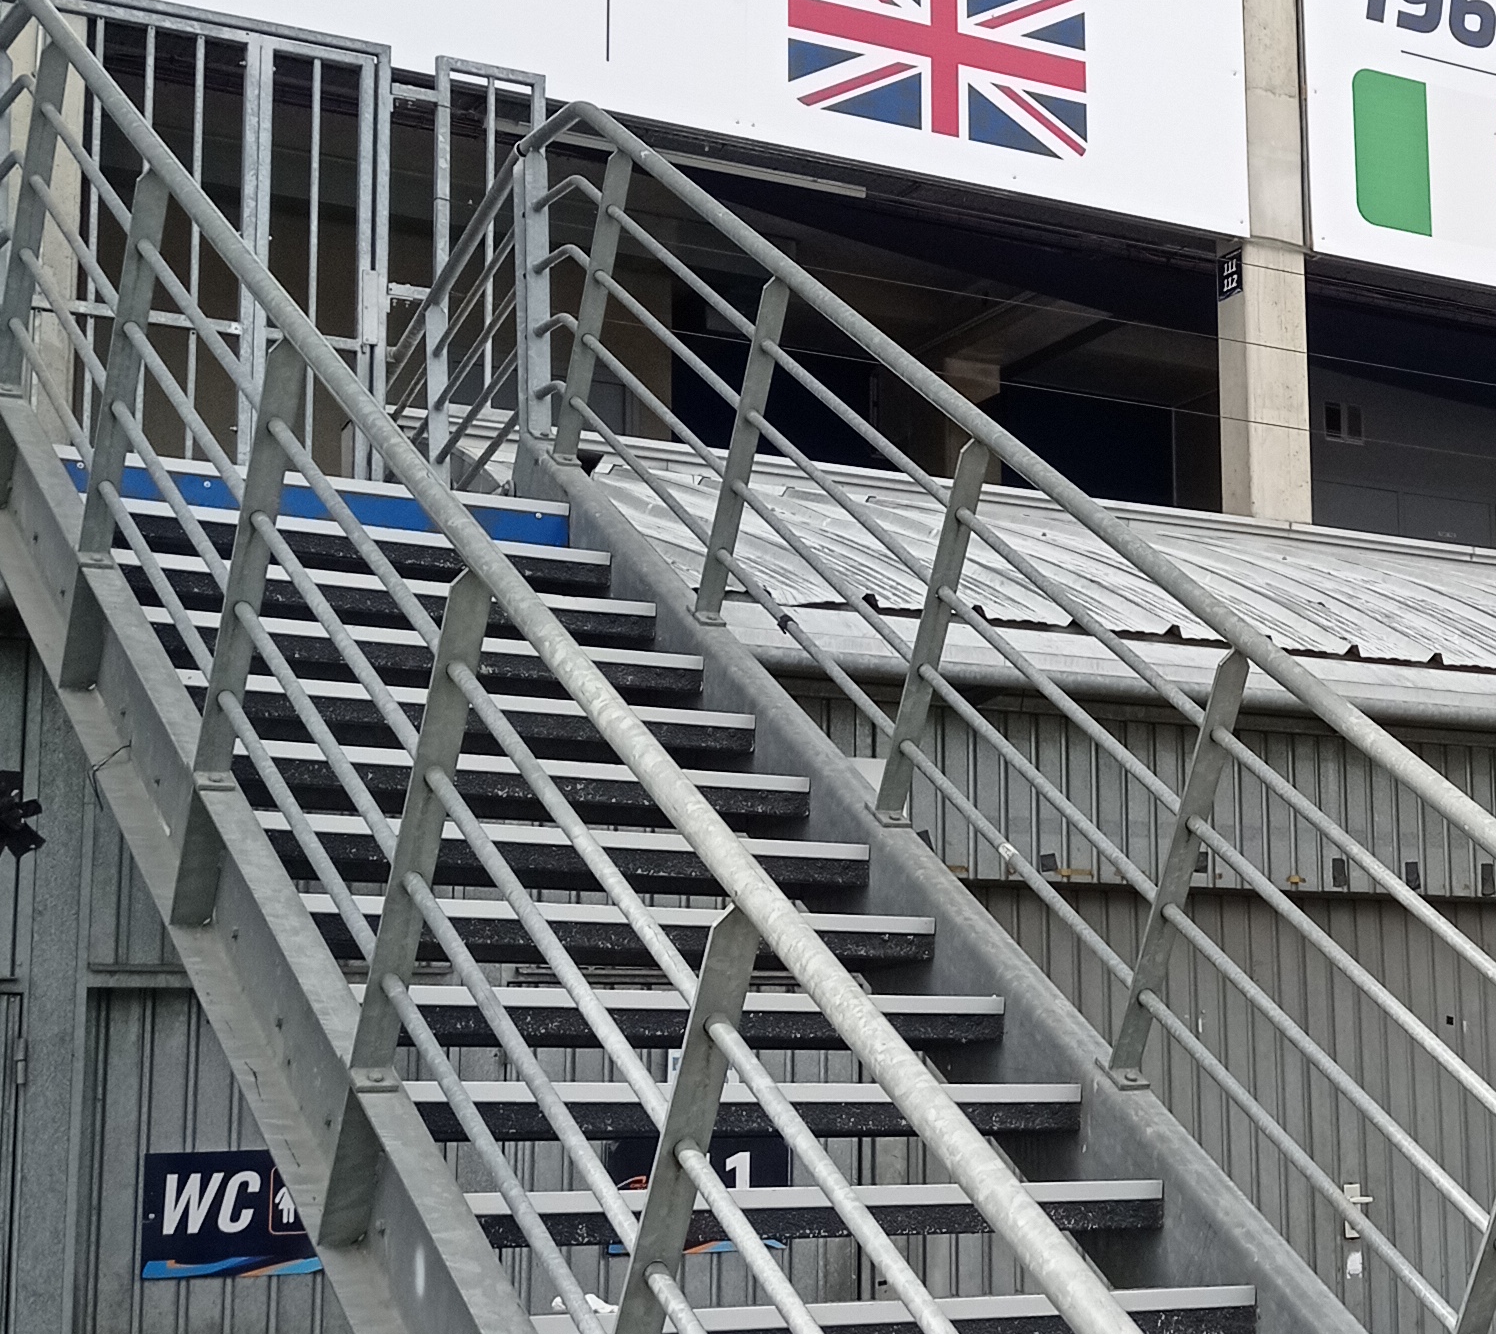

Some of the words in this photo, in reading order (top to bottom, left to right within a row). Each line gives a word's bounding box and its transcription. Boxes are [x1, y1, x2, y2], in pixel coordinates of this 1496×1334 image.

[1223, 258, 1236, 276] 111
[1223, 274, 1238, 292] 112
[162, 1170, 262, 1236] WC
